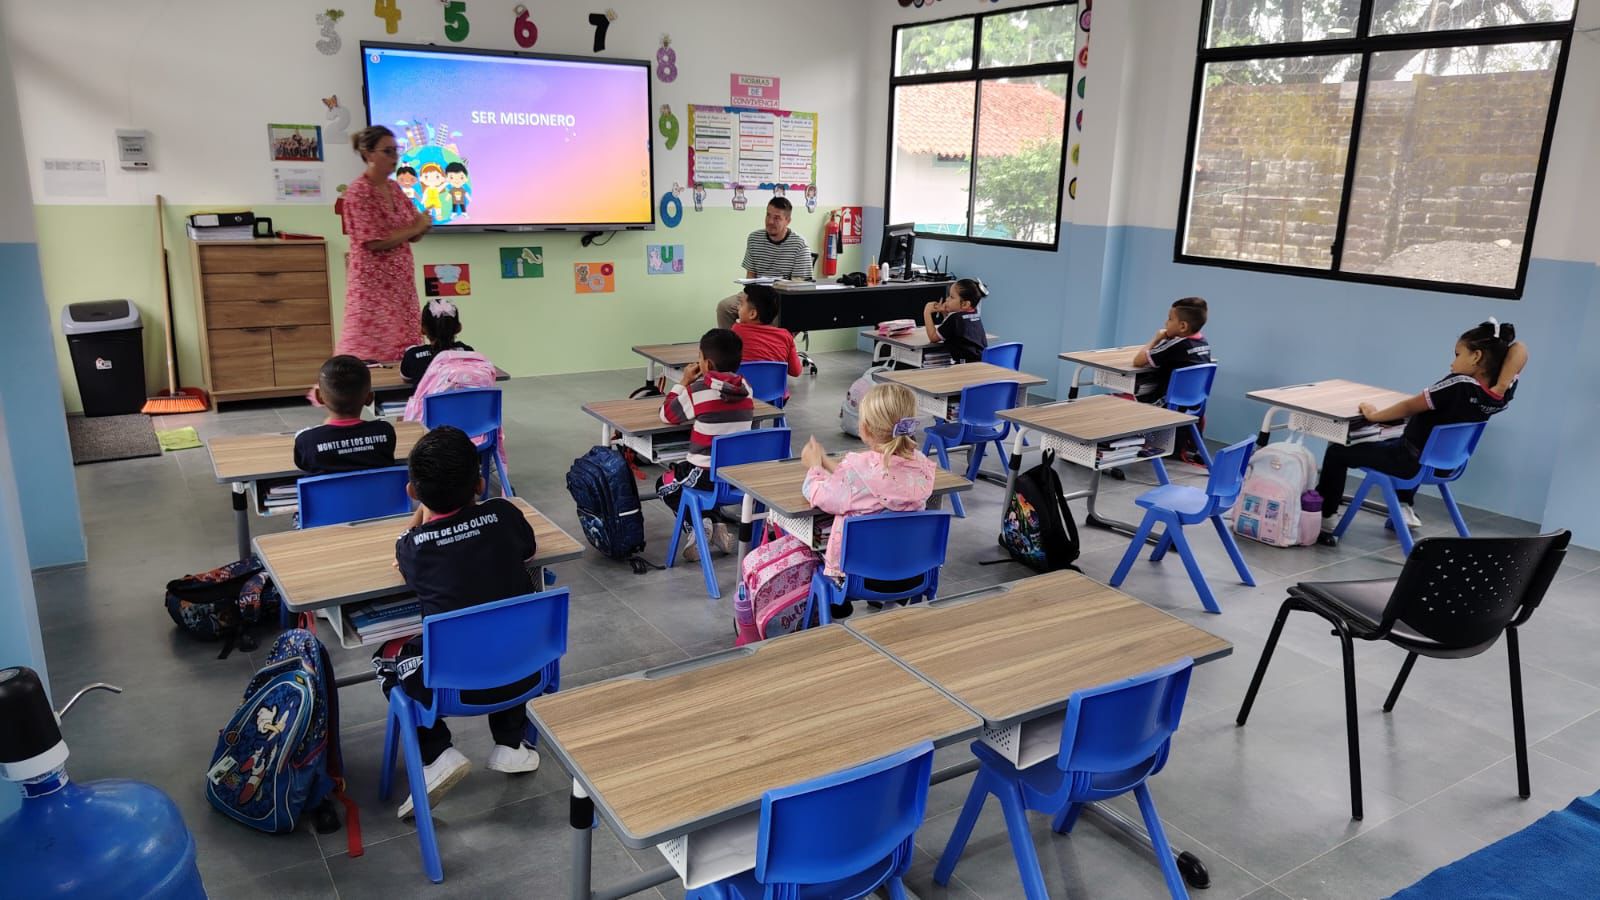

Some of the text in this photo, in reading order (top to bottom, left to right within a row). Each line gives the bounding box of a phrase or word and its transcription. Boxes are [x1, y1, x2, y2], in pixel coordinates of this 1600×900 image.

[374, 0, 402, 34] 4
[444, 1, 470, 42] 5
[513, 9, 538, 48] 6
[588, 13, 610, 53] 7
[656, 46, 678, 83] 8
[471, 111, 576, 127] SER MISIONERO
[658, 111, 680, 150] 9
[317, 434, 387, 452] MONTE DE LOS OLIVOS
[413, 513, 498, 546] MONTE DE LOS OLIVOS
